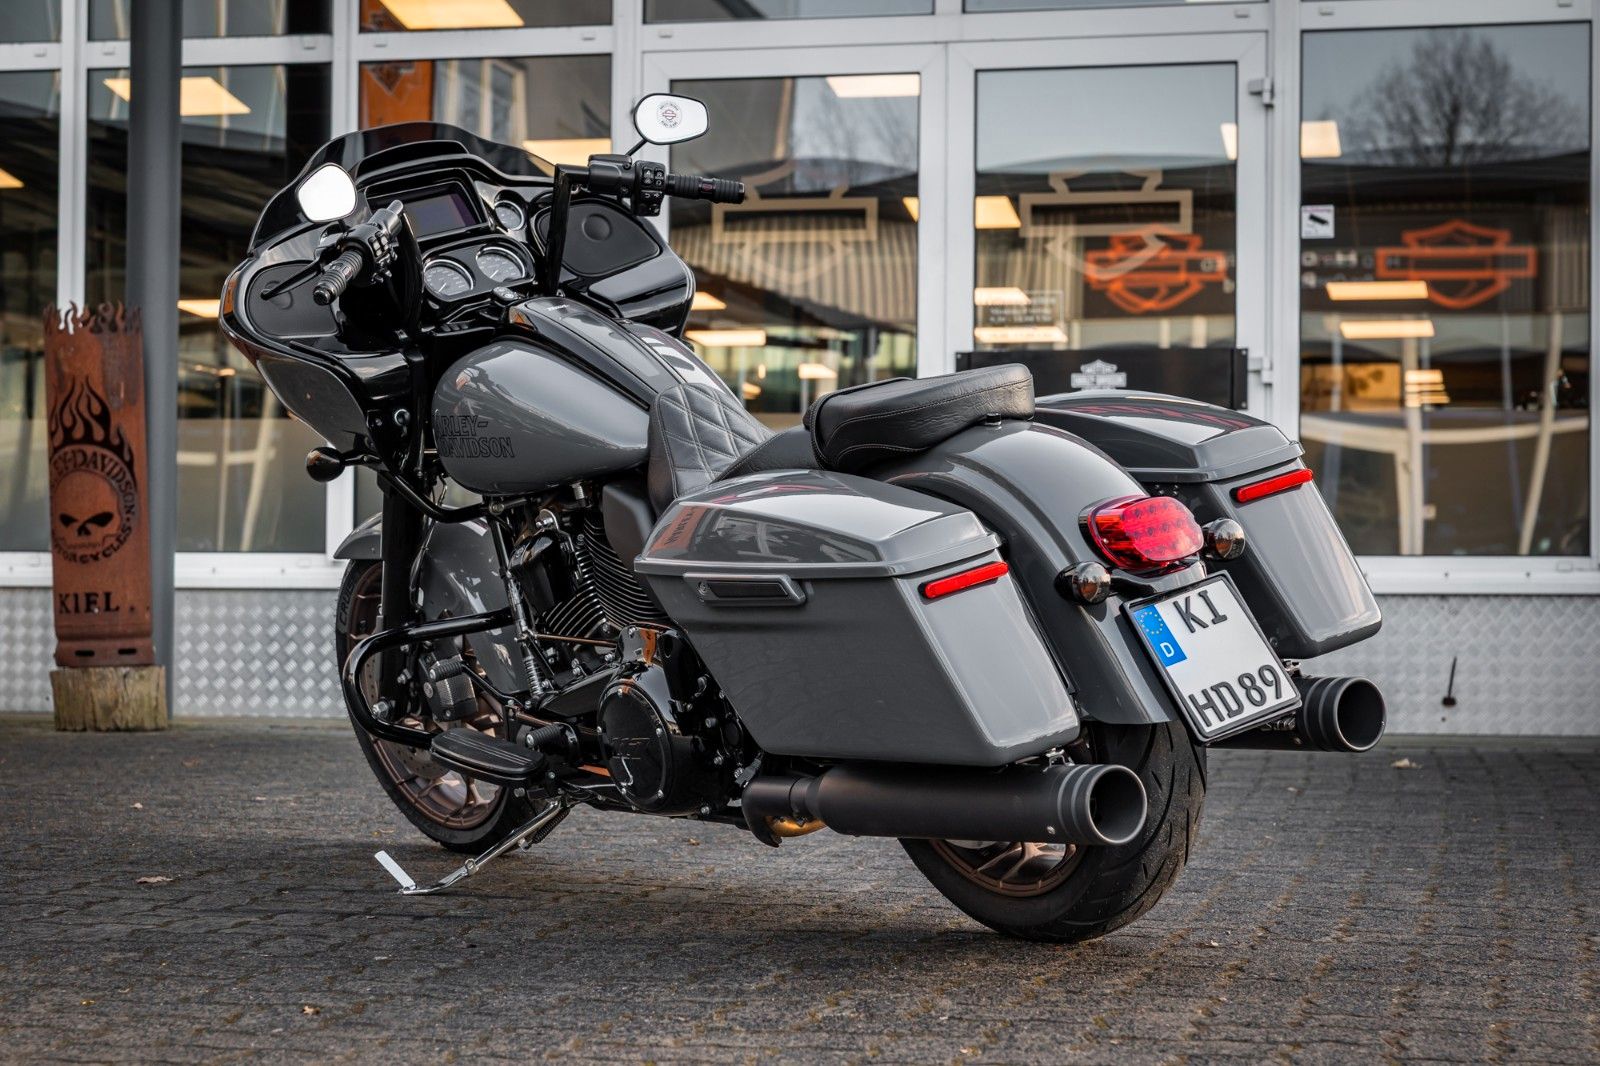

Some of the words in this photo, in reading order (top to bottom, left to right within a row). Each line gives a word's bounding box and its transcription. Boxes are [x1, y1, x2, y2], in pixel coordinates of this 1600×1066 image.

[58, 591, 120, 615] KIEL
[1172, 589, 1228, 634] KI
[1159, 641, 1175, 659] D
